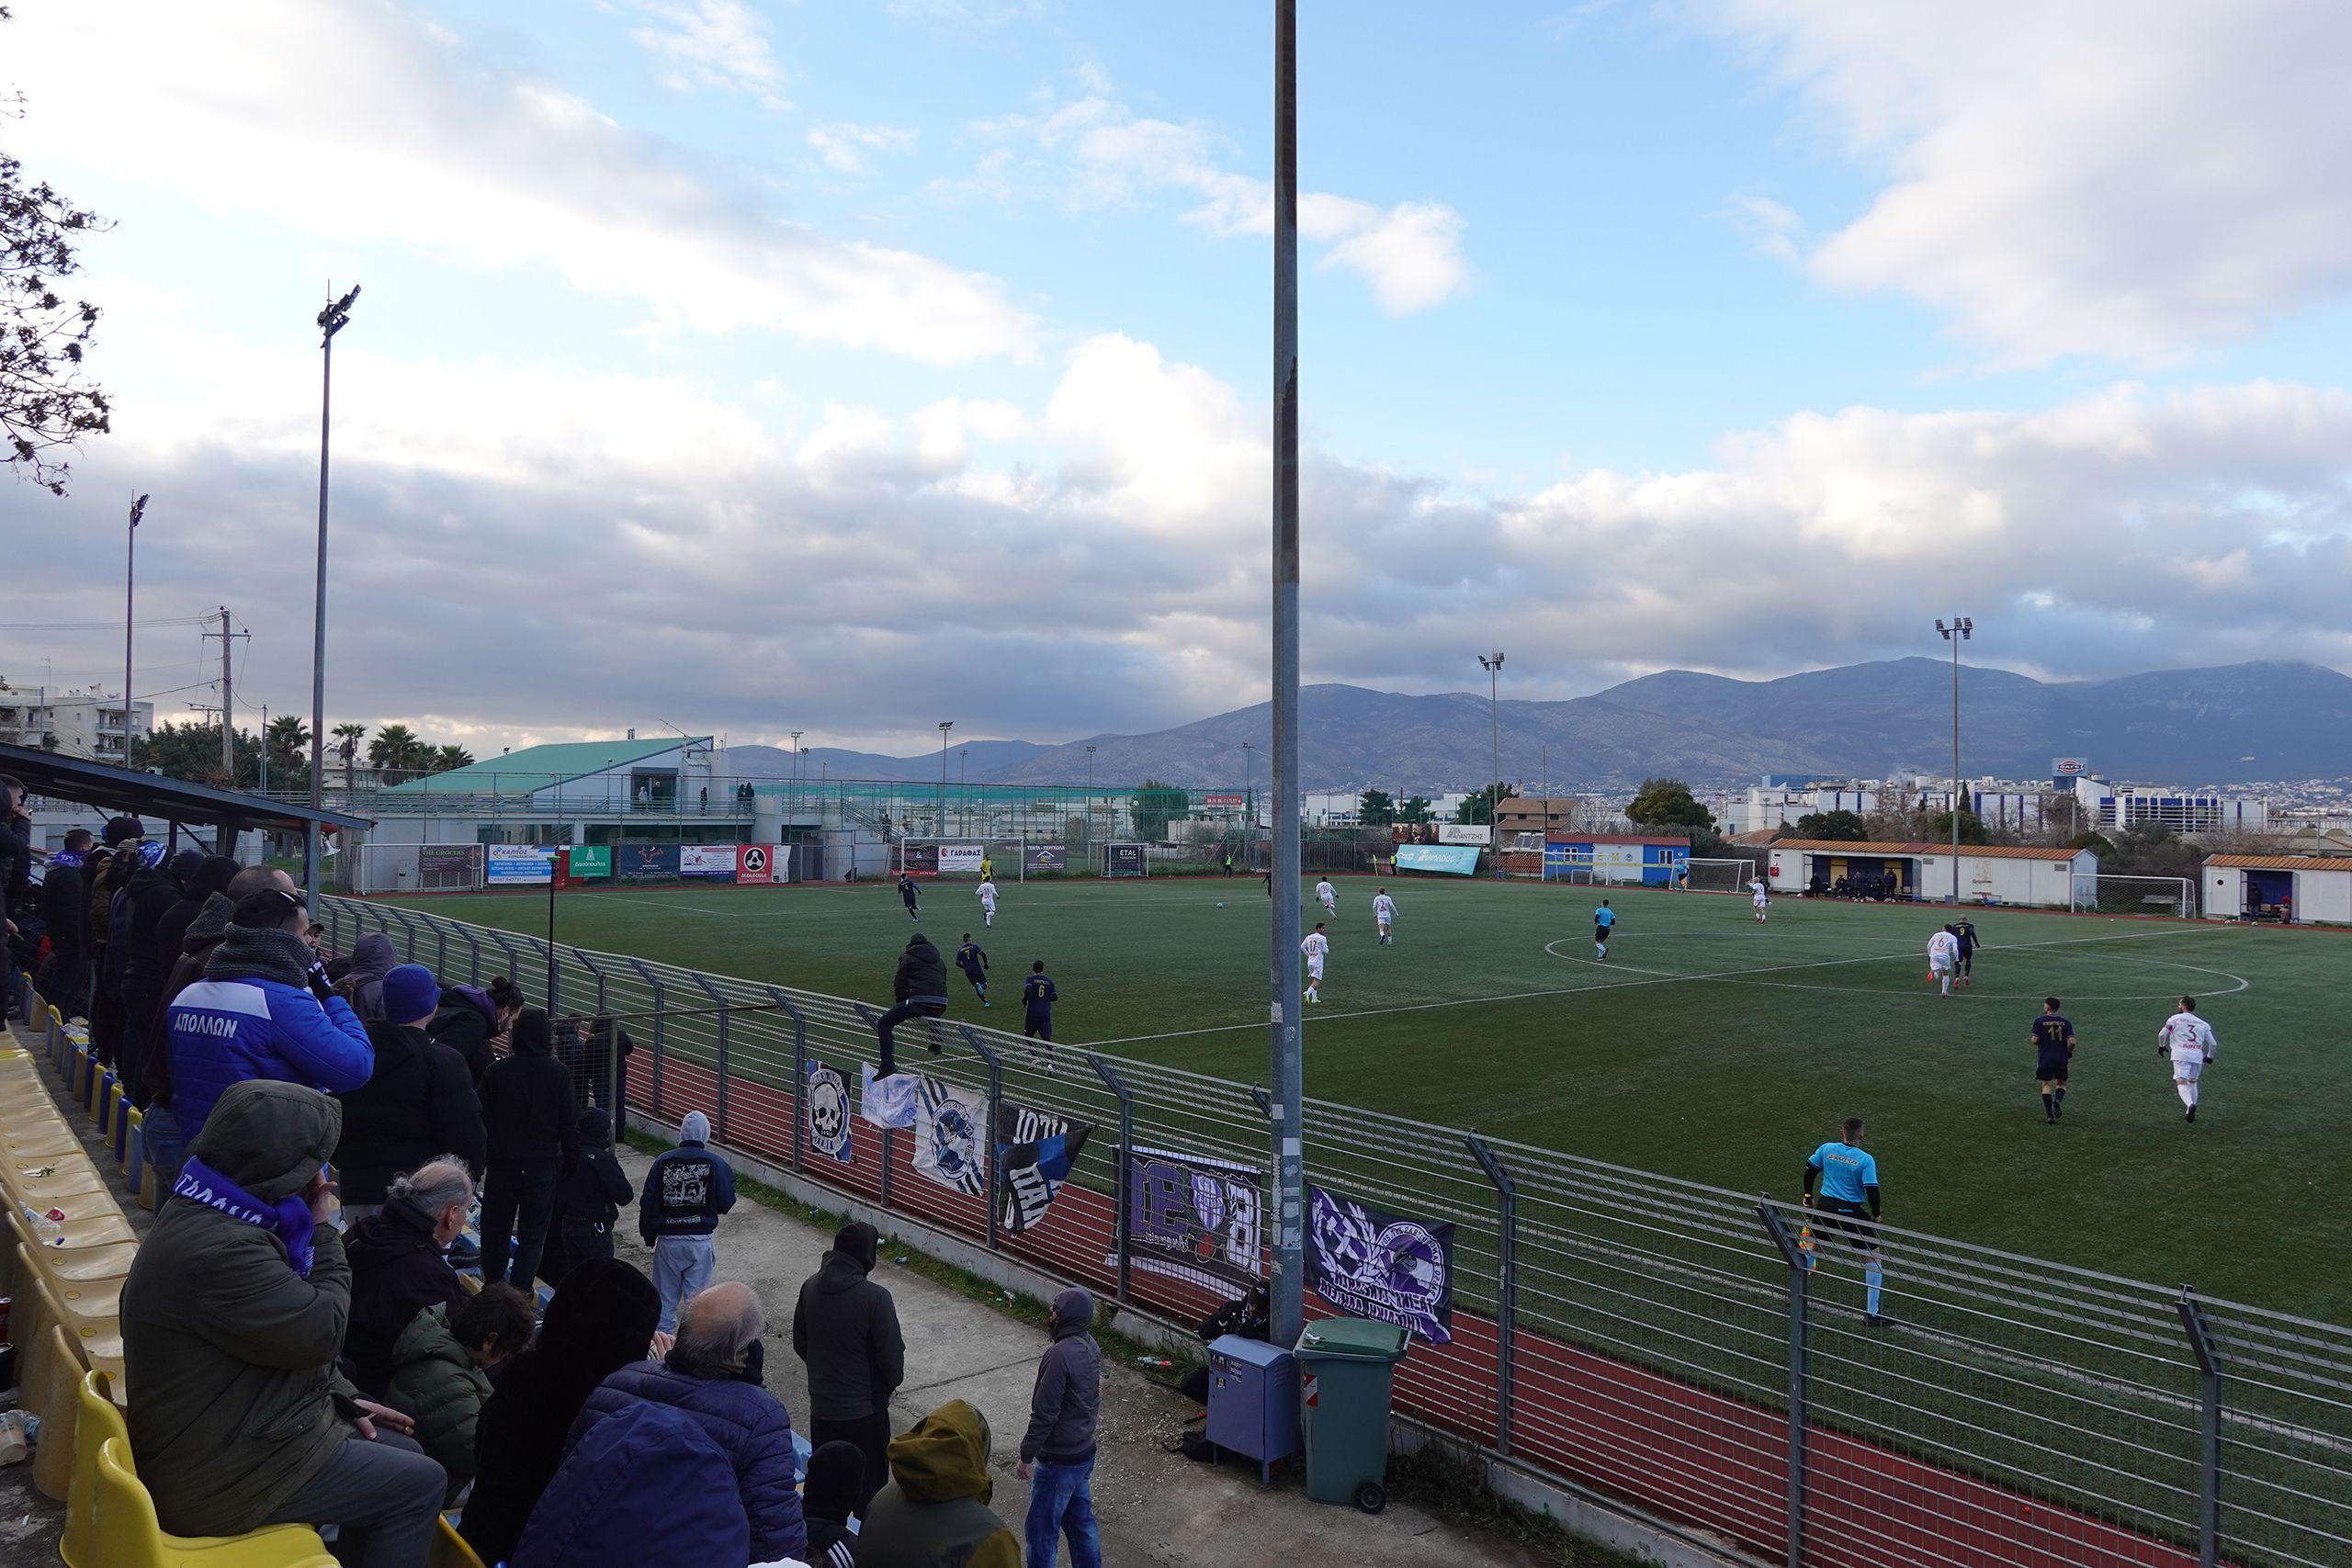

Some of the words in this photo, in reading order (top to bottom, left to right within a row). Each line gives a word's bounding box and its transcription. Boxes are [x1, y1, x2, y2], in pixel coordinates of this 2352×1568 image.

[1038, 984, 1046, 998] 6
[174, 1012, 239, 1039] ΑΠΟΛΛΩΝ
[2047, 1025, 2064, 1042] 11
[2188, 1024, 2196, 1042] 3
